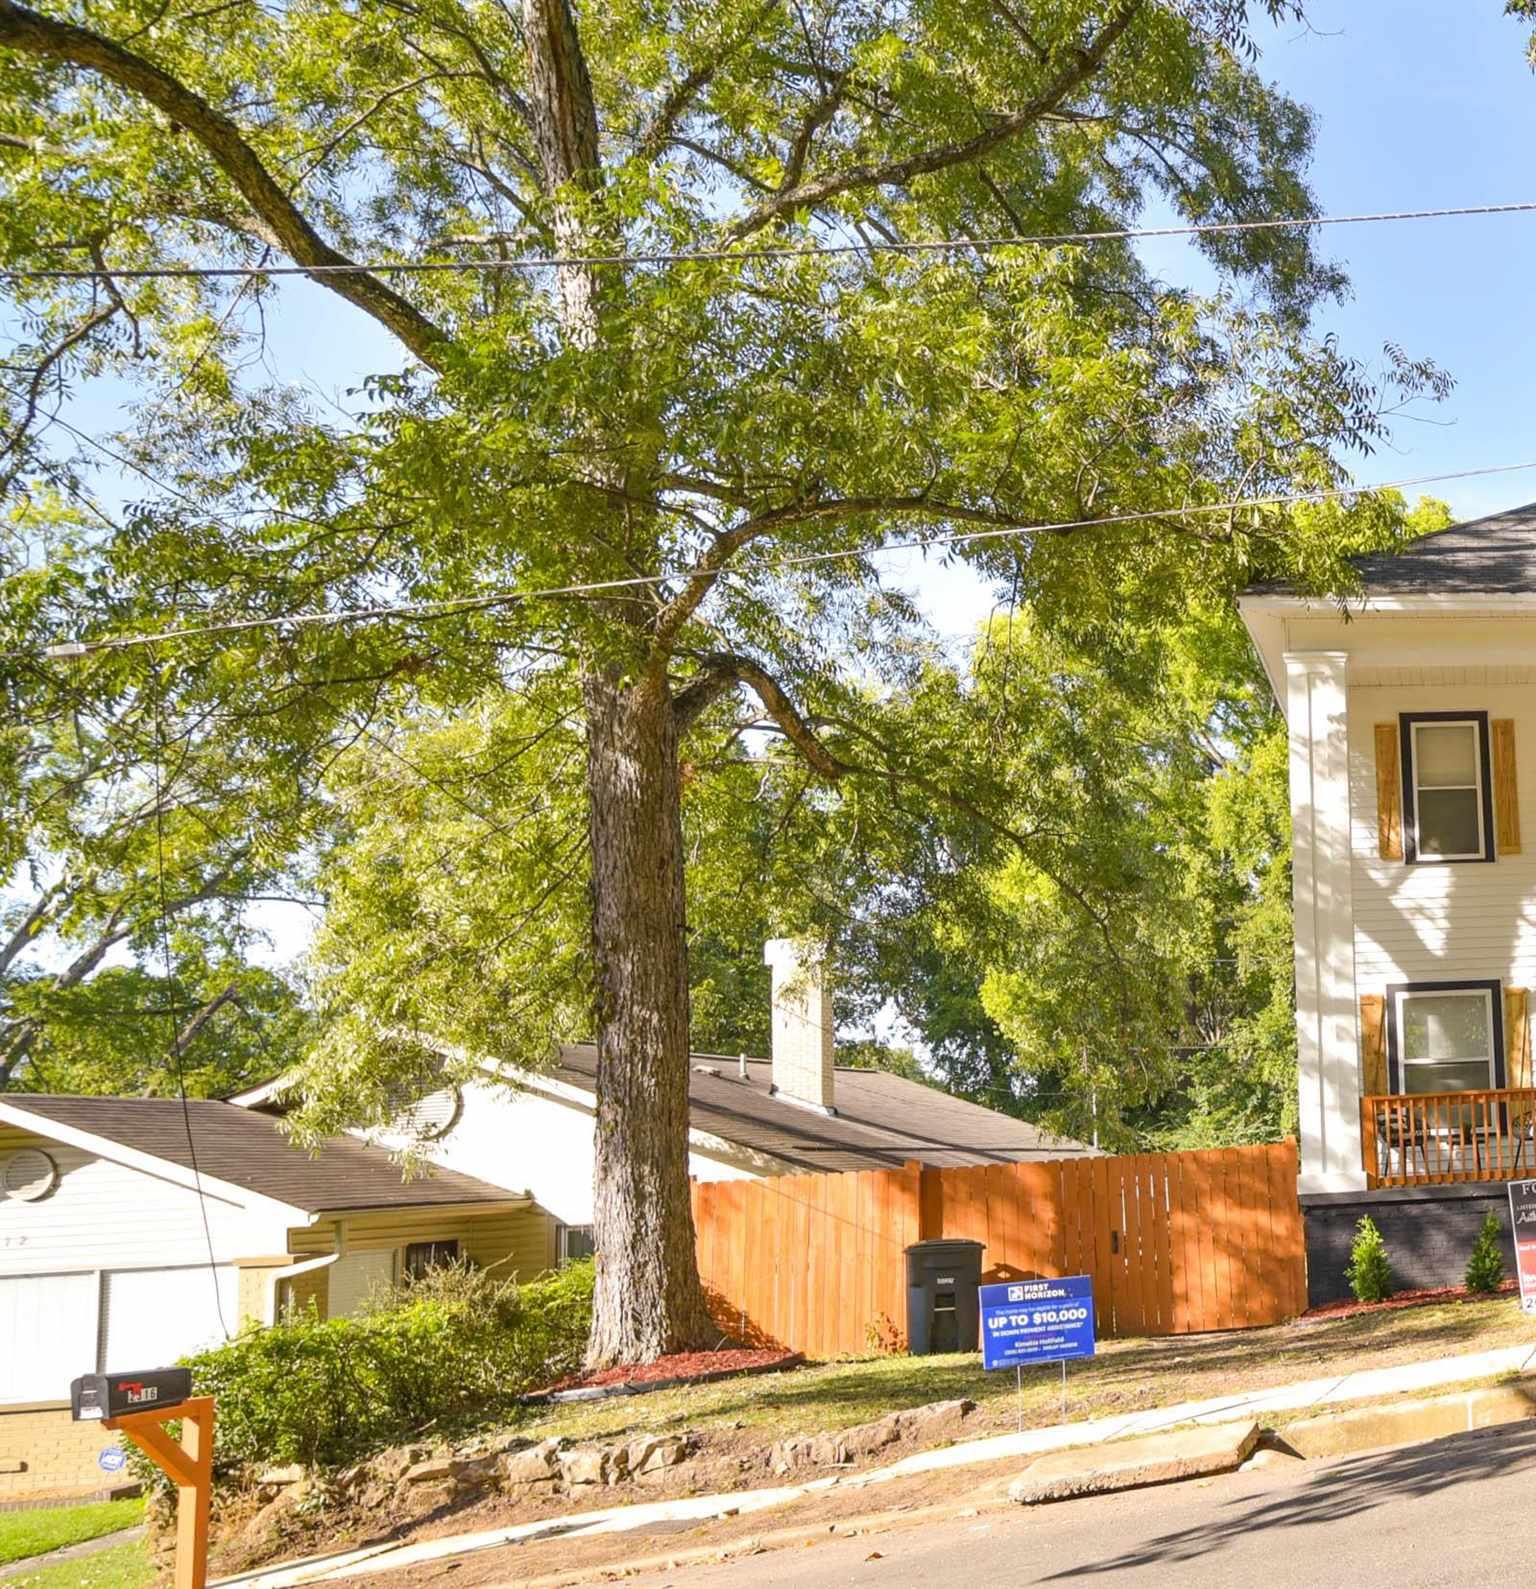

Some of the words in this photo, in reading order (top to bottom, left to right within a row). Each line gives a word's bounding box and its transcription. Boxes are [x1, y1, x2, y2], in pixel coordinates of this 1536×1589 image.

[1024, 1283, 1049, 1292] FIRST
[988, 1316, 1008, 1329] UP
[1009, 1314, 1029, 1327] TO
[1032, 1307, 1088, 1325] $10,000
